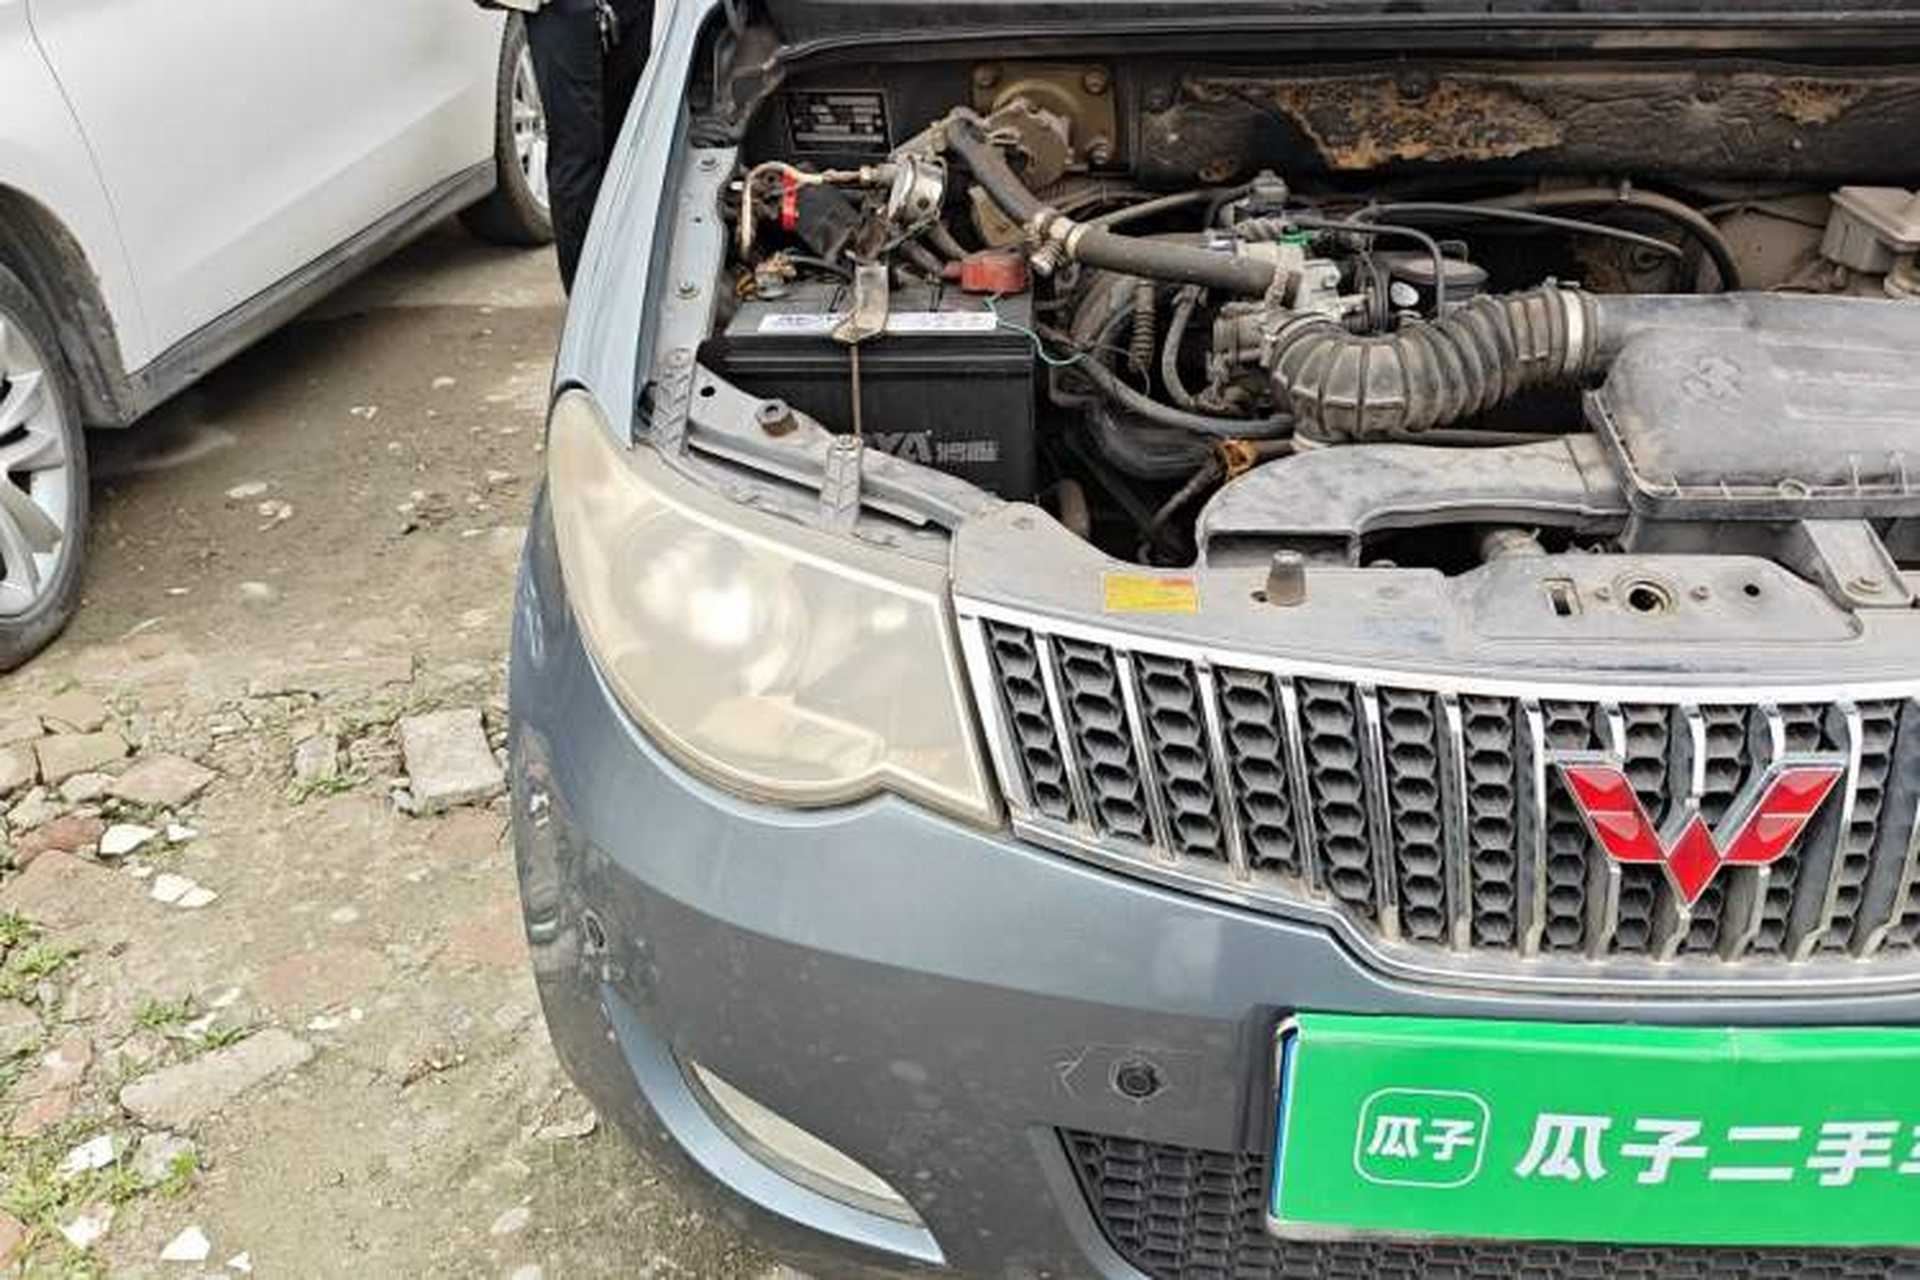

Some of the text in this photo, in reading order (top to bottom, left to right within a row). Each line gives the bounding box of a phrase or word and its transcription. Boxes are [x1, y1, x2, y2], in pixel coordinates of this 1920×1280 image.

[1366, 1115, 1475, 1161] 瓜子
[1514, 1113, 1920, 1183] 瓜子二手
